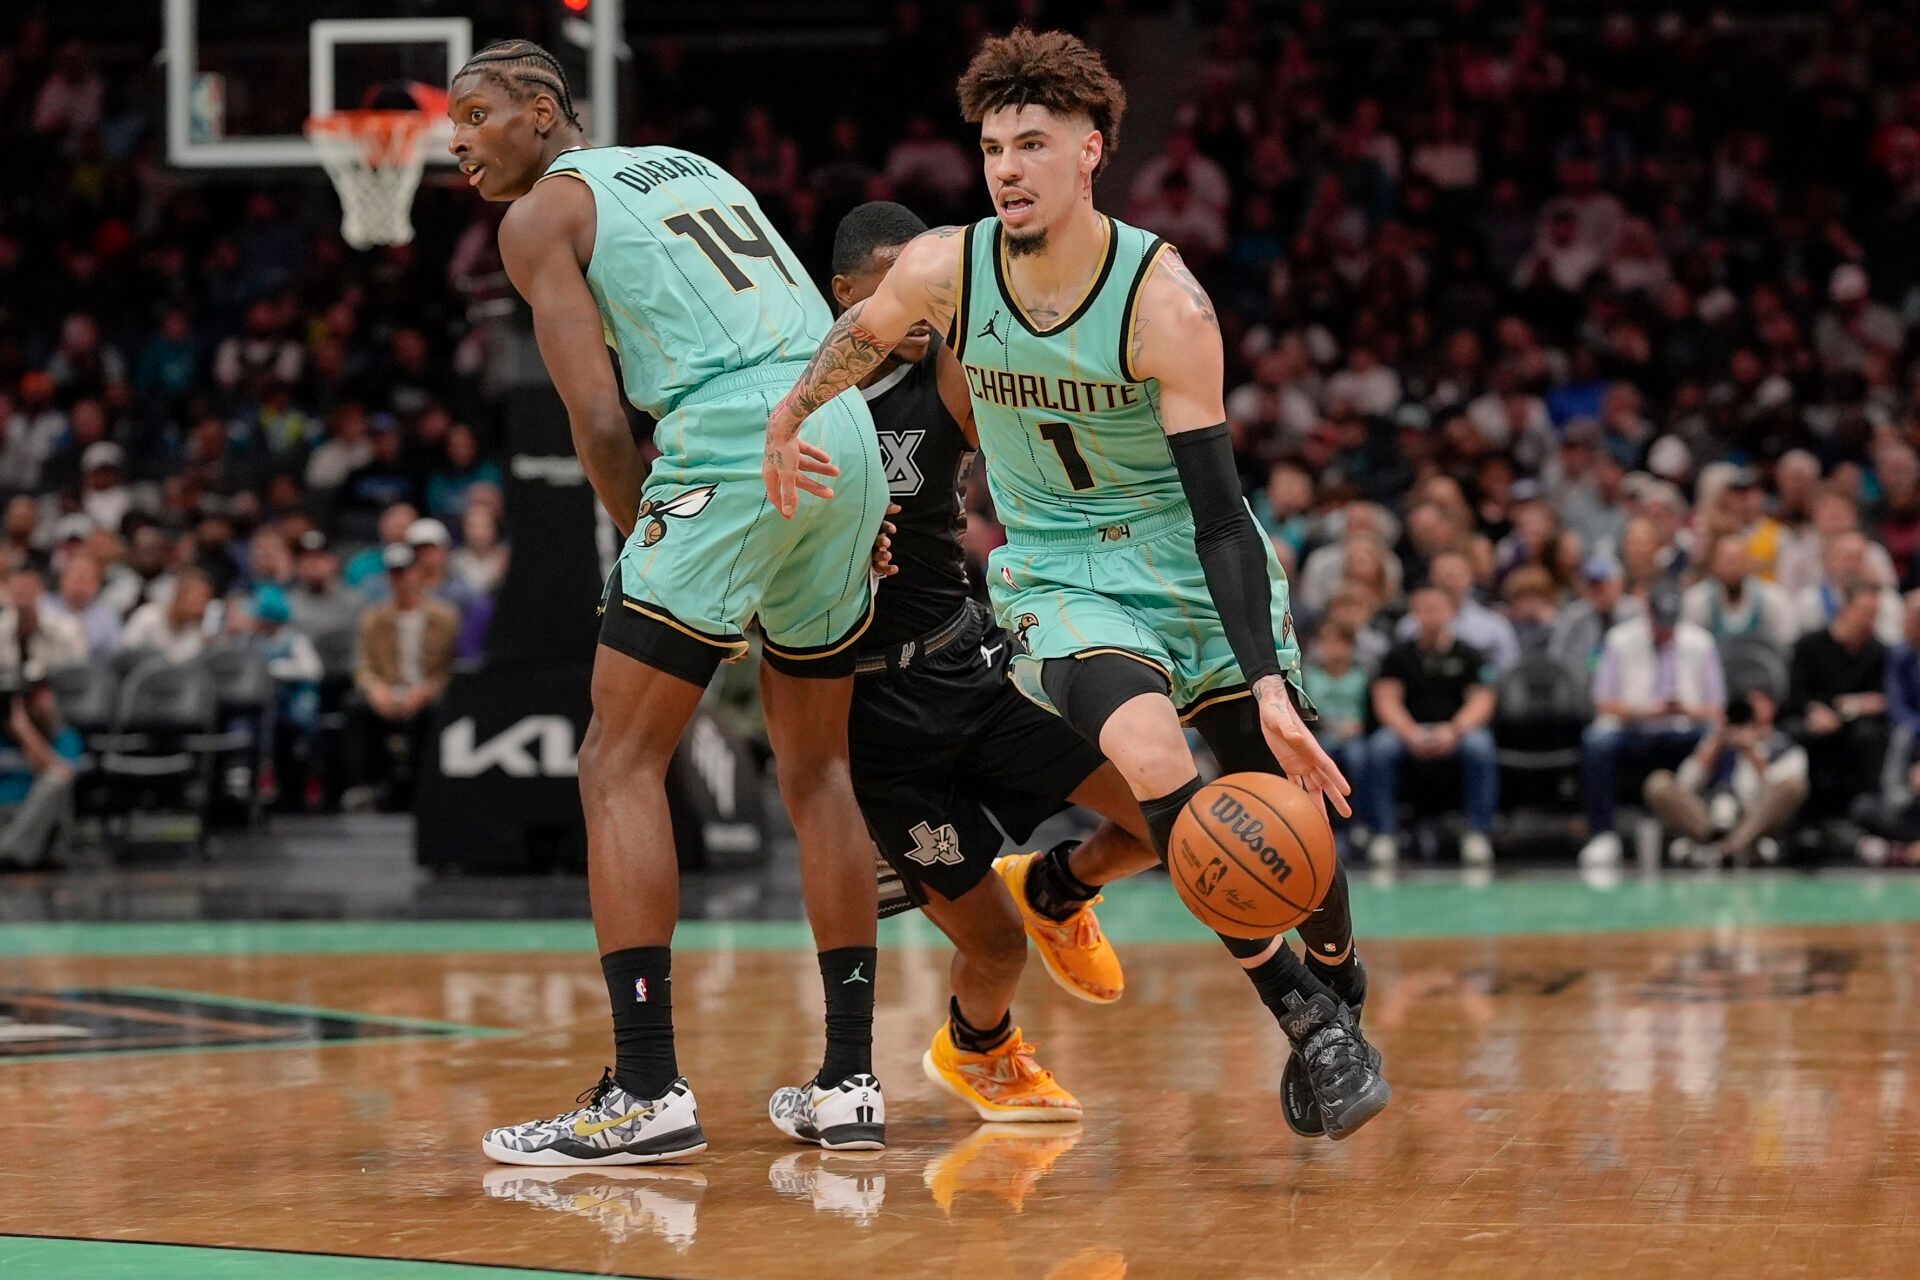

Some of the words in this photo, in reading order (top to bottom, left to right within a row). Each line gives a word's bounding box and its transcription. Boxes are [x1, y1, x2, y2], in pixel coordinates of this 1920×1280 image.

[613, 156, 719, 195] DIABATE
[662, 204, 800, 295] 14
[965, 364, 1139, 413] CHARLOTTE
[1037, 421, 1096, 492] 1
[1210, 792, 1294, 886] Wilson
[862, 1091, 869, 1102] 2
